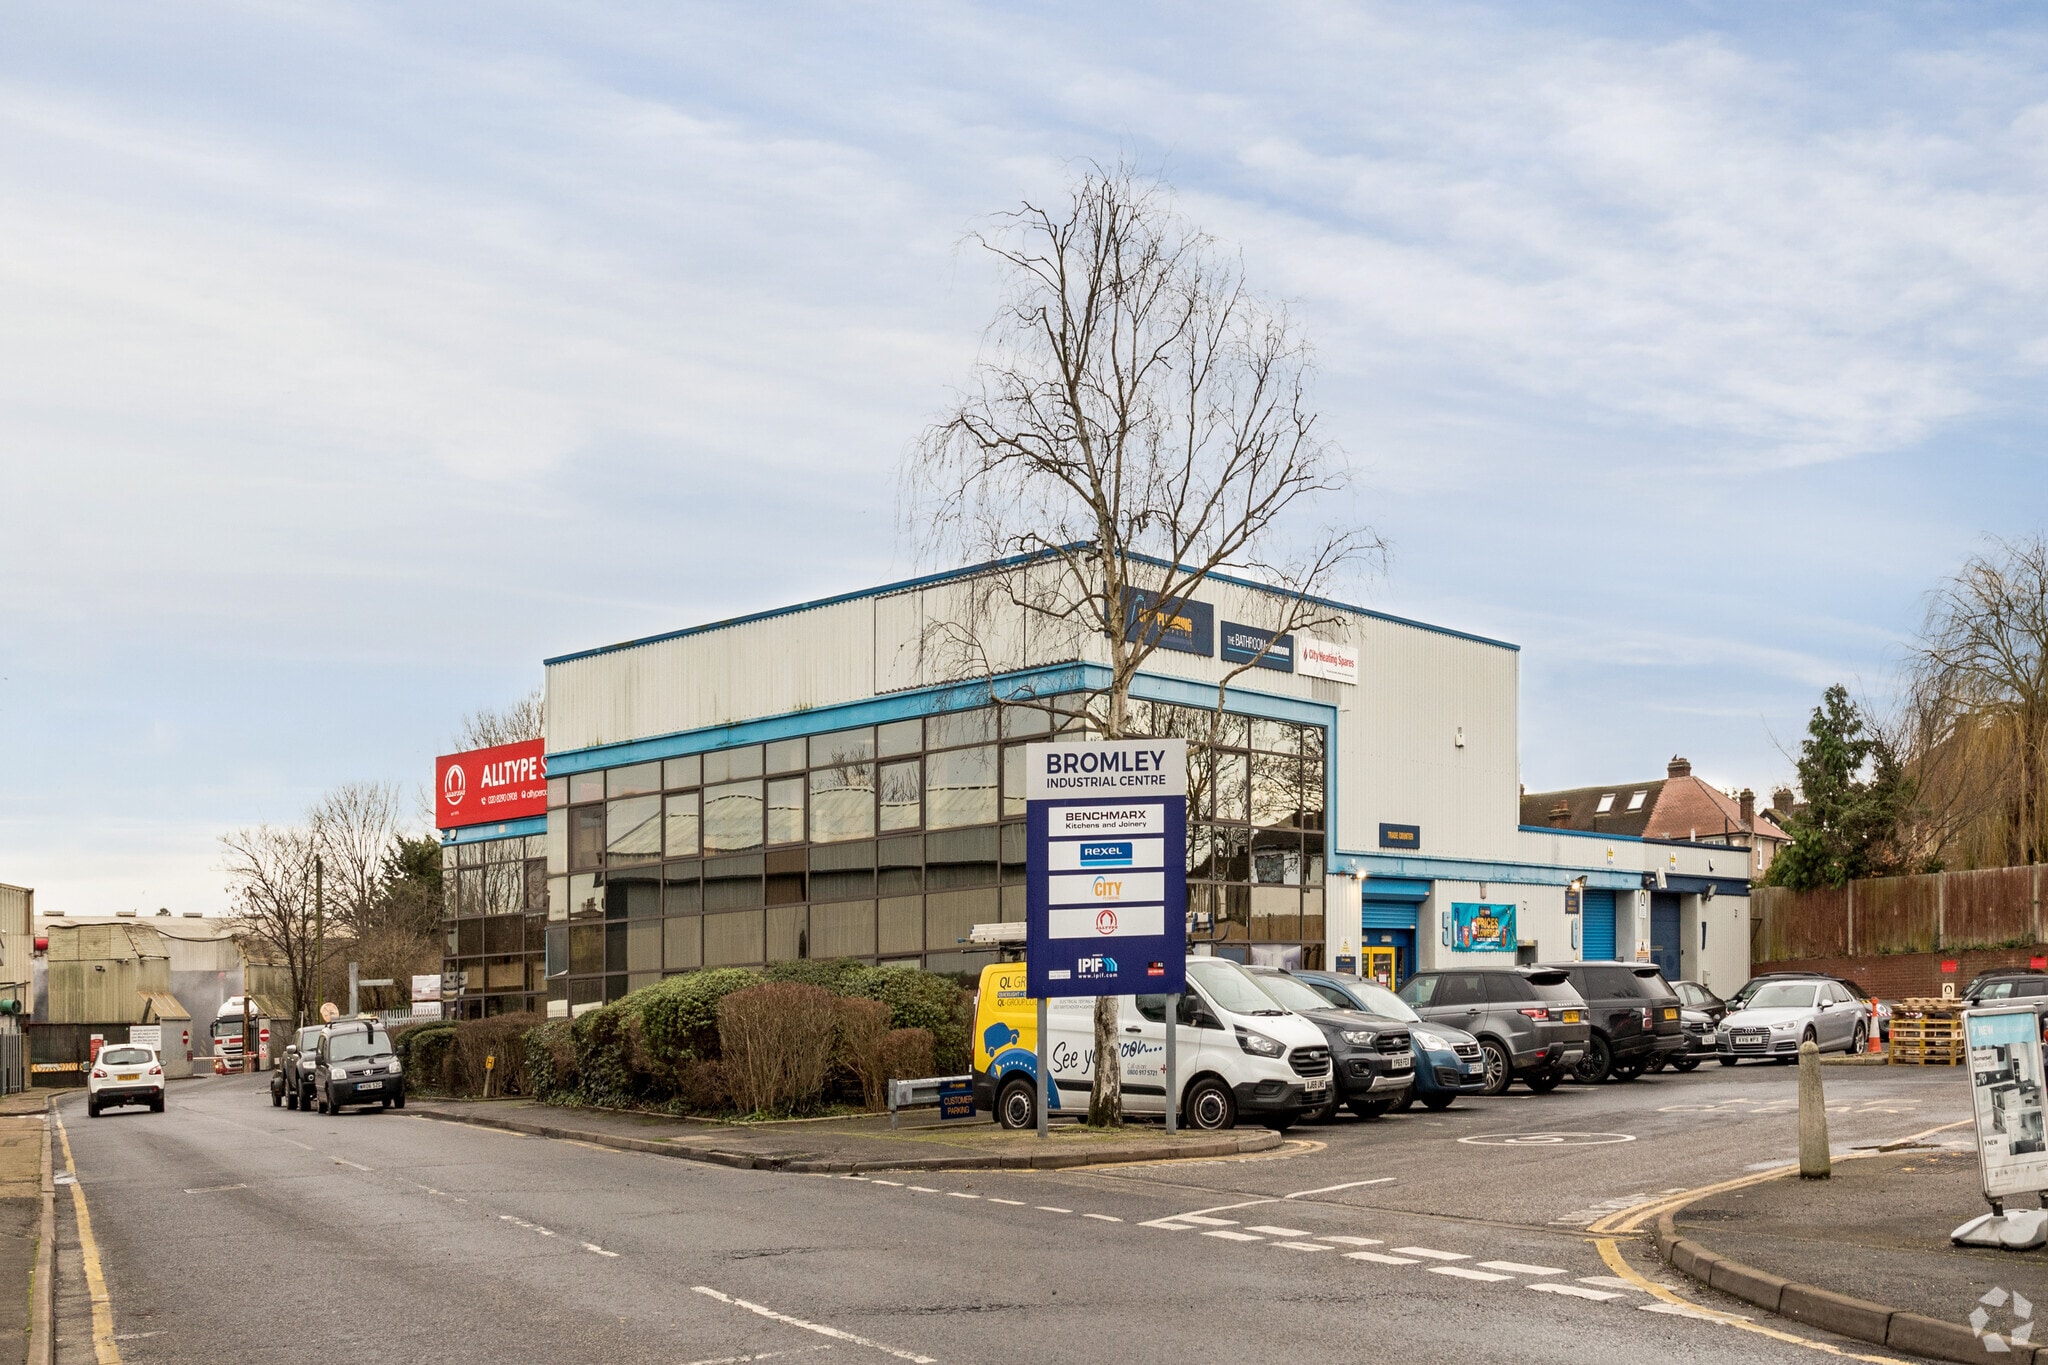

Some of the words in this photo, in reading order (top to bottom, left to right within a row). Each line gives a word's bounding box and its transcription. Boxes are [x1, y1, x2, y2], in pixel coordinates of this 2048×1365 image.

[1227, 635, 1235, 646] THE
[1235, 633, 1266, 651] BATHROOM
[1309, 649, 1319, 663] City
[1319, 651, 1337, 666] Heating
[1338, 655, 1355, 668] Spares
[1046, 750, 1166, 775] BROMLEY
[480, 756, 537, 788] ALLTYPE
[1046, 776, 1117, 789] INDUSTRIAL
[1119, 774, 1166, 787] CENTRE
[1065, 810, 1146, 821] BENCHMARX
[1065, 822, 1100, 830] Kitchens
[1118, 821, 1147, 829] Joinery
[1094, 881, 1122, 897] CITY
[1476, 917, 1499, 929] PRICES
[1077, 957, 1103, 973] IPIF
[1000, 976, 1011, 990] QL
[1053, 1041, 1078, 1073] See
[1118, 1040, 1162, 1058] oon...
[944, 1095, 973, 1105] CUSTOMER
[947, 1105, 970, 1115] PARKING
